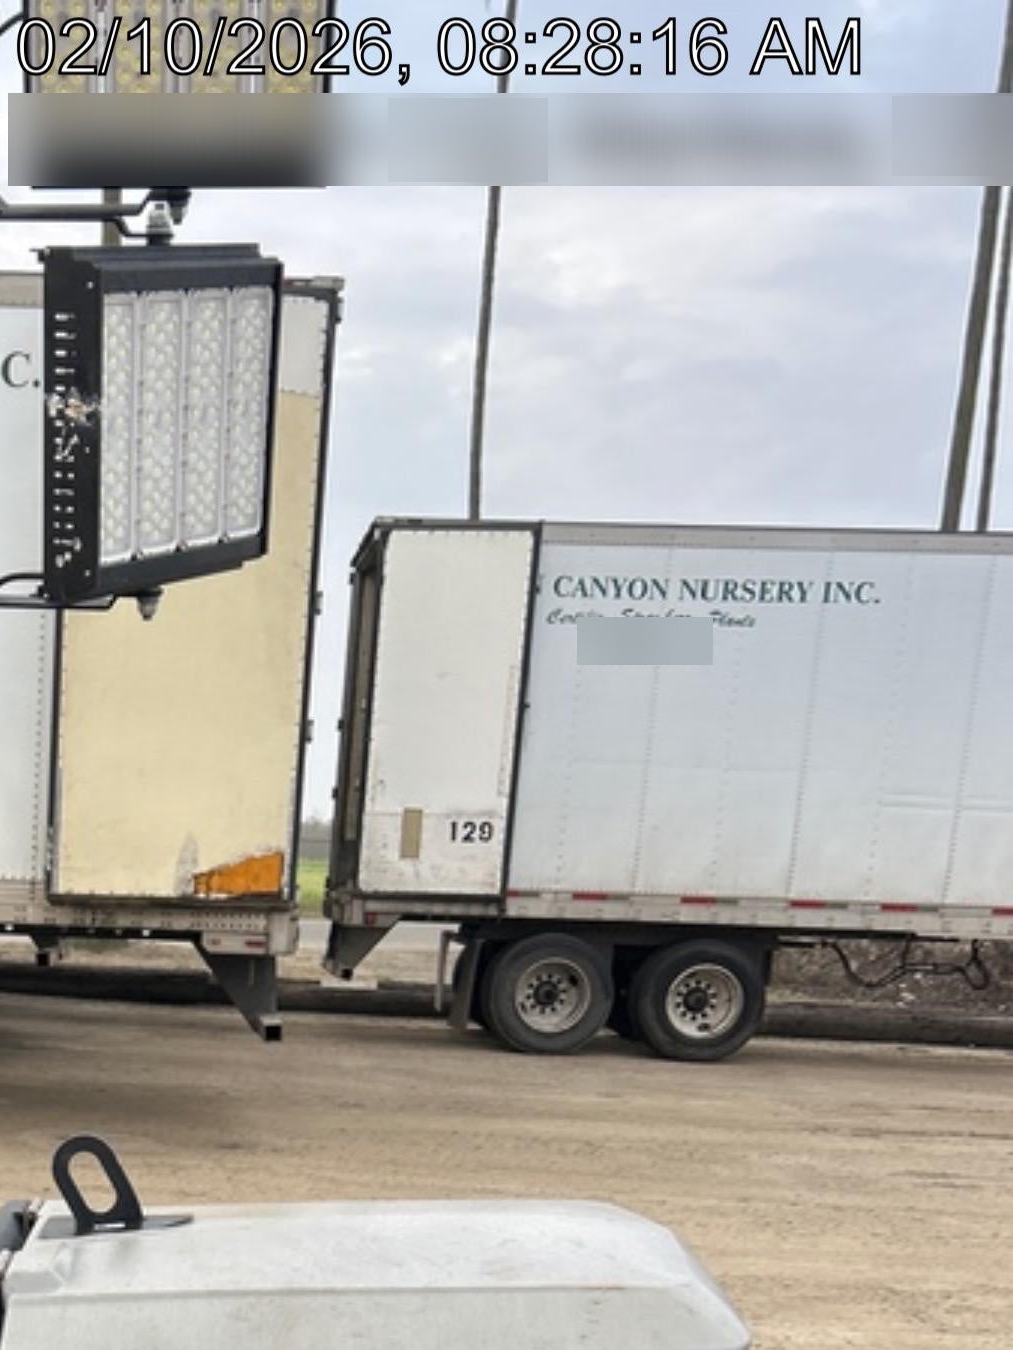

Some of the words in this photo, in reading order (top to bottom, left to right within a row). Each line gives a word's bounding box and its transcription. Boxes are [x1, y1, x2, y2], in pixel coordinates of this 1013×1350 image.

[552, 575, 670, 601] CANYON
[678, 578, 814, 604] NURSERY
[822, 580, 881, 605] INC.
[450, 820, 494, 844] 129
